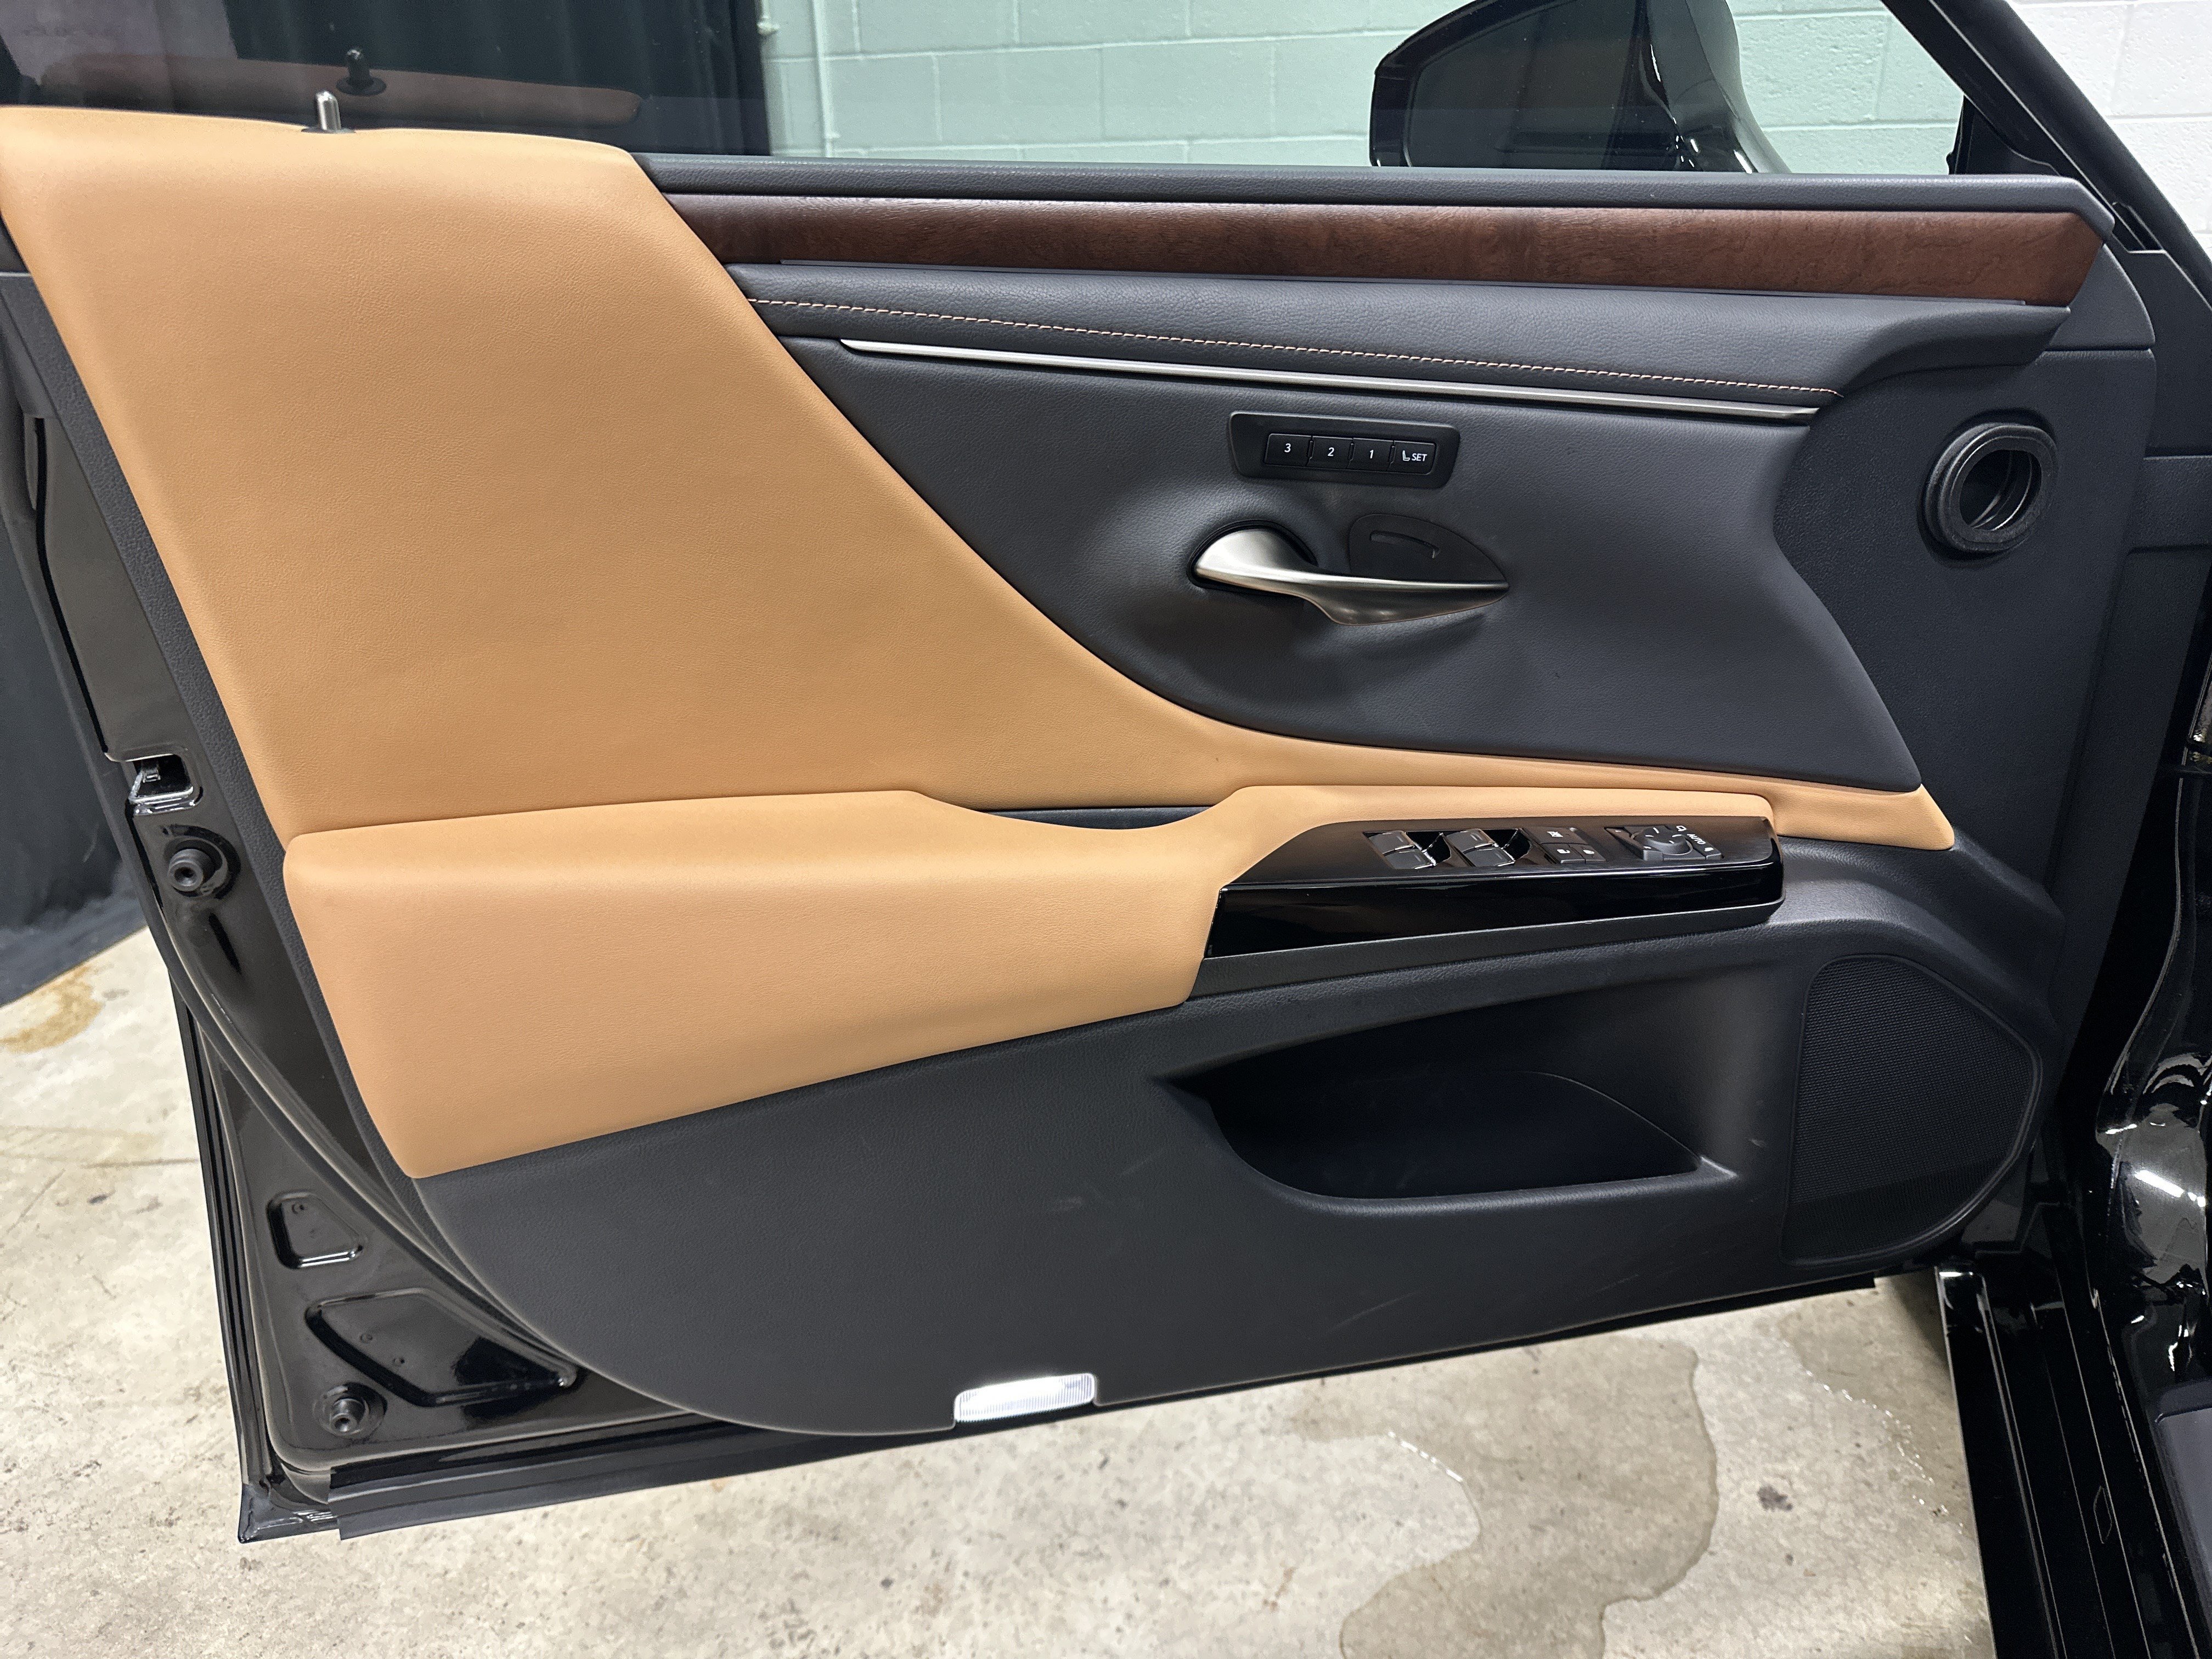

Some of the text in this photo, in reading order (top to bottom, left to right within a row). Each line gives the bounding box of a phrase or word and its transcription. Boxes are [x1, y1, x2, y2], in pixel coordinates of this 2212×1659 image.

[1284, 443, 1291, 453] 3
[1328, 447, 1335, 456] 2
[1370, 449, 1374, 459] 1
[1412, 453, 1427, 461] SET
[1686, 834, 1706, 844] AUTO
